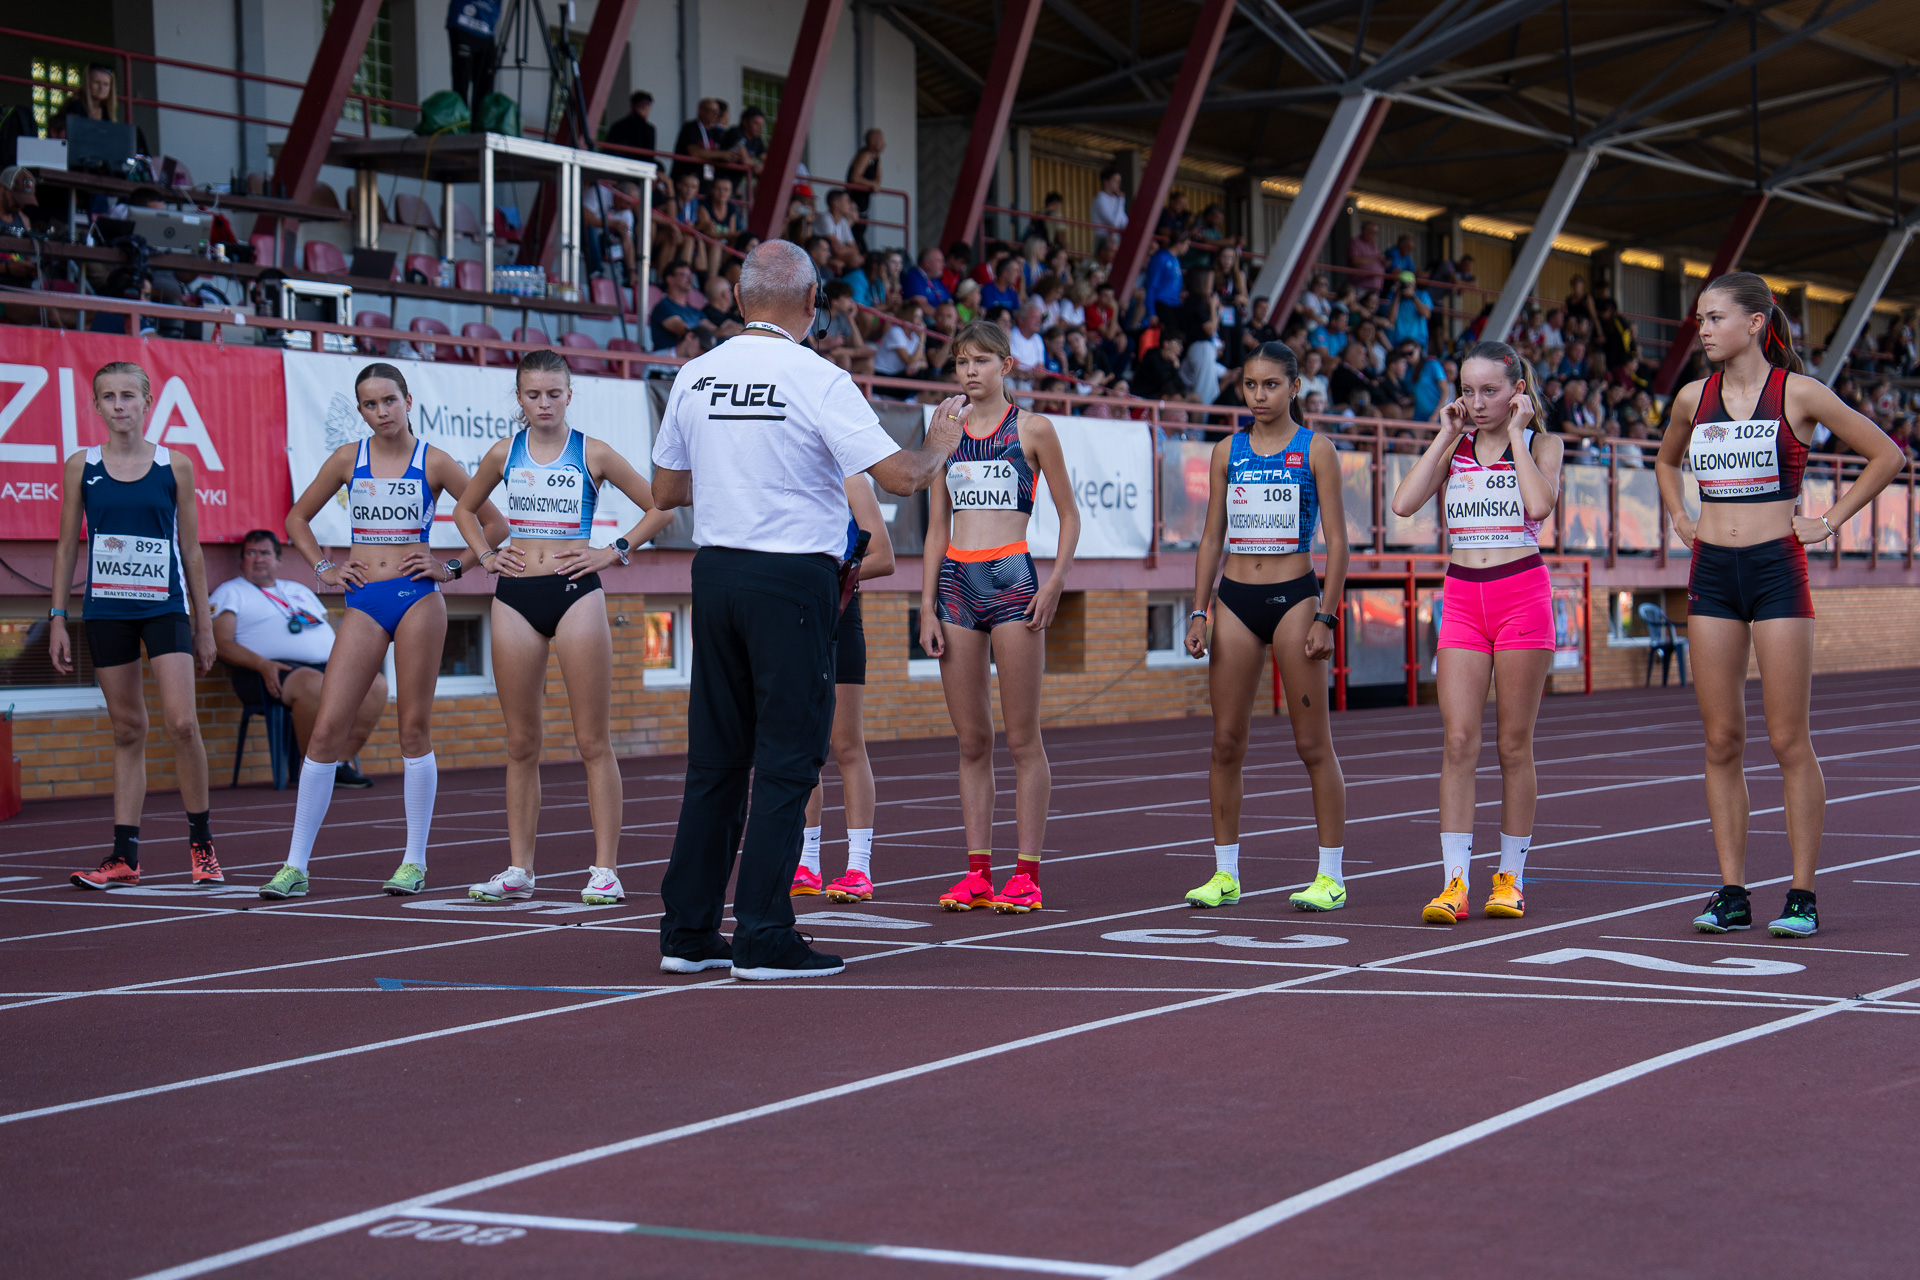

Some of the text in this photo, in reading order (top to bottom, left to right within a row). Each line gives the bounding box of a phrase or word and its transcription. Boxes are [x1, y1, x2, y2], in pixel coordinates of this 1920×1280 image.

[691, 376, 717, 391] 4F
[710, 384, 787, 408] FUEL
[420, 403, 524, 439] Minister
[1734, 424, 1775, 440] 1026
[1694, 450, 1774, 471] LEONOWICZ
[547, 473, 576, 487] 696
[983, 465, 1012, 479] 716
[1235, 469, 1293, 481] VECTRA
[388, 482, 416, 496] 753
[1486, 475, 1517, 489] 683
[1745, 485, 1765, 493] 2024
[0, 481, 59, 503] ĄZEK
[954, 490, 1012, 506] ŁAGUNA
[1263, 488, 1293, 502] 108
[509, 492, 579, 514] ĆWIGOŃ SZYMCZAK
[1447, 497, 1521, 519] KAMIŃSKA
[353, 503, 419, 521] GRADOŃ
[135, 540, 163, 554] 892
[96, 560, 165, 579] WASZAK
[103, 590, 138, 598] BIAŁYSTOK
[400, 897, 630, 915] 5
[1100, 927, 1350, 950] 3
[1509, 946, 1808, 977] 2
